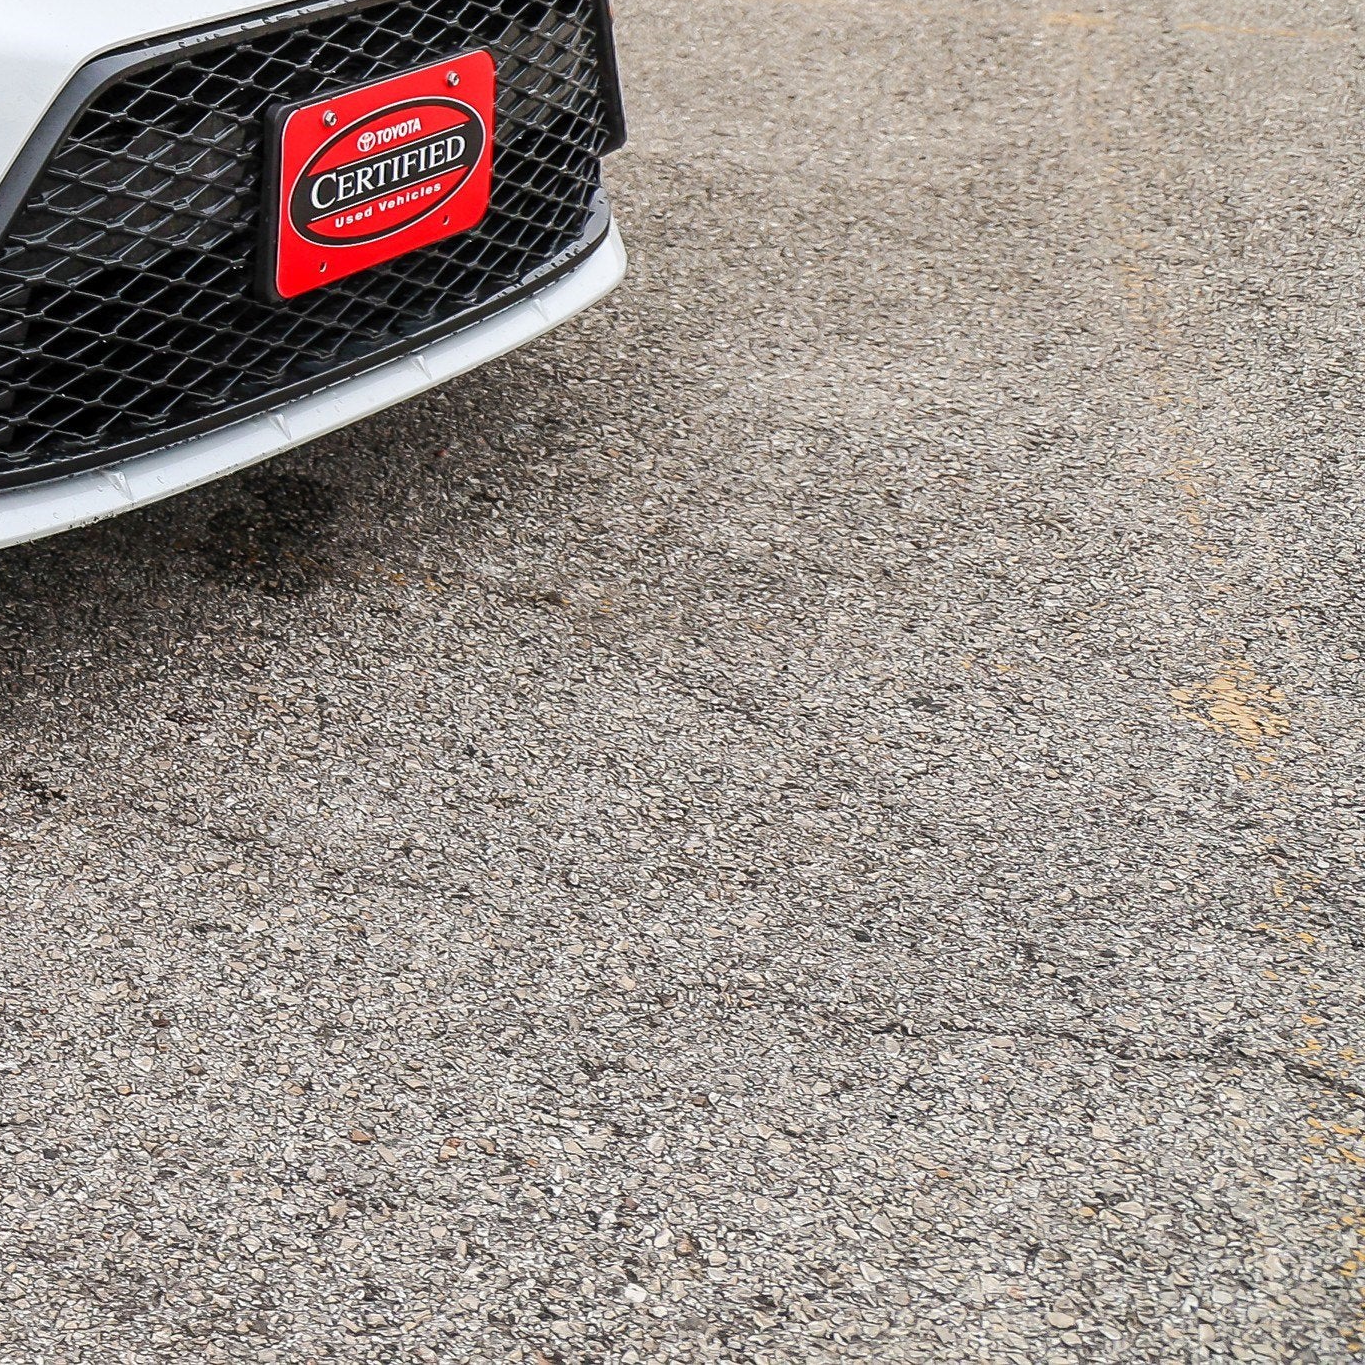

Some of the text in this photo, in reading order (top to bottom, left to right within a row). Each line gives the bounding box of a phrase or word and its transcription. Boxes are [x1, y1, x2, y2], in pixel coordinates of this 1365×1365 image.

[375, 117, 422, 146] TOYOTA
[311, 134, 466, 210] CERTIFIED
[335, 182, 442, 228] Used Vehicles
